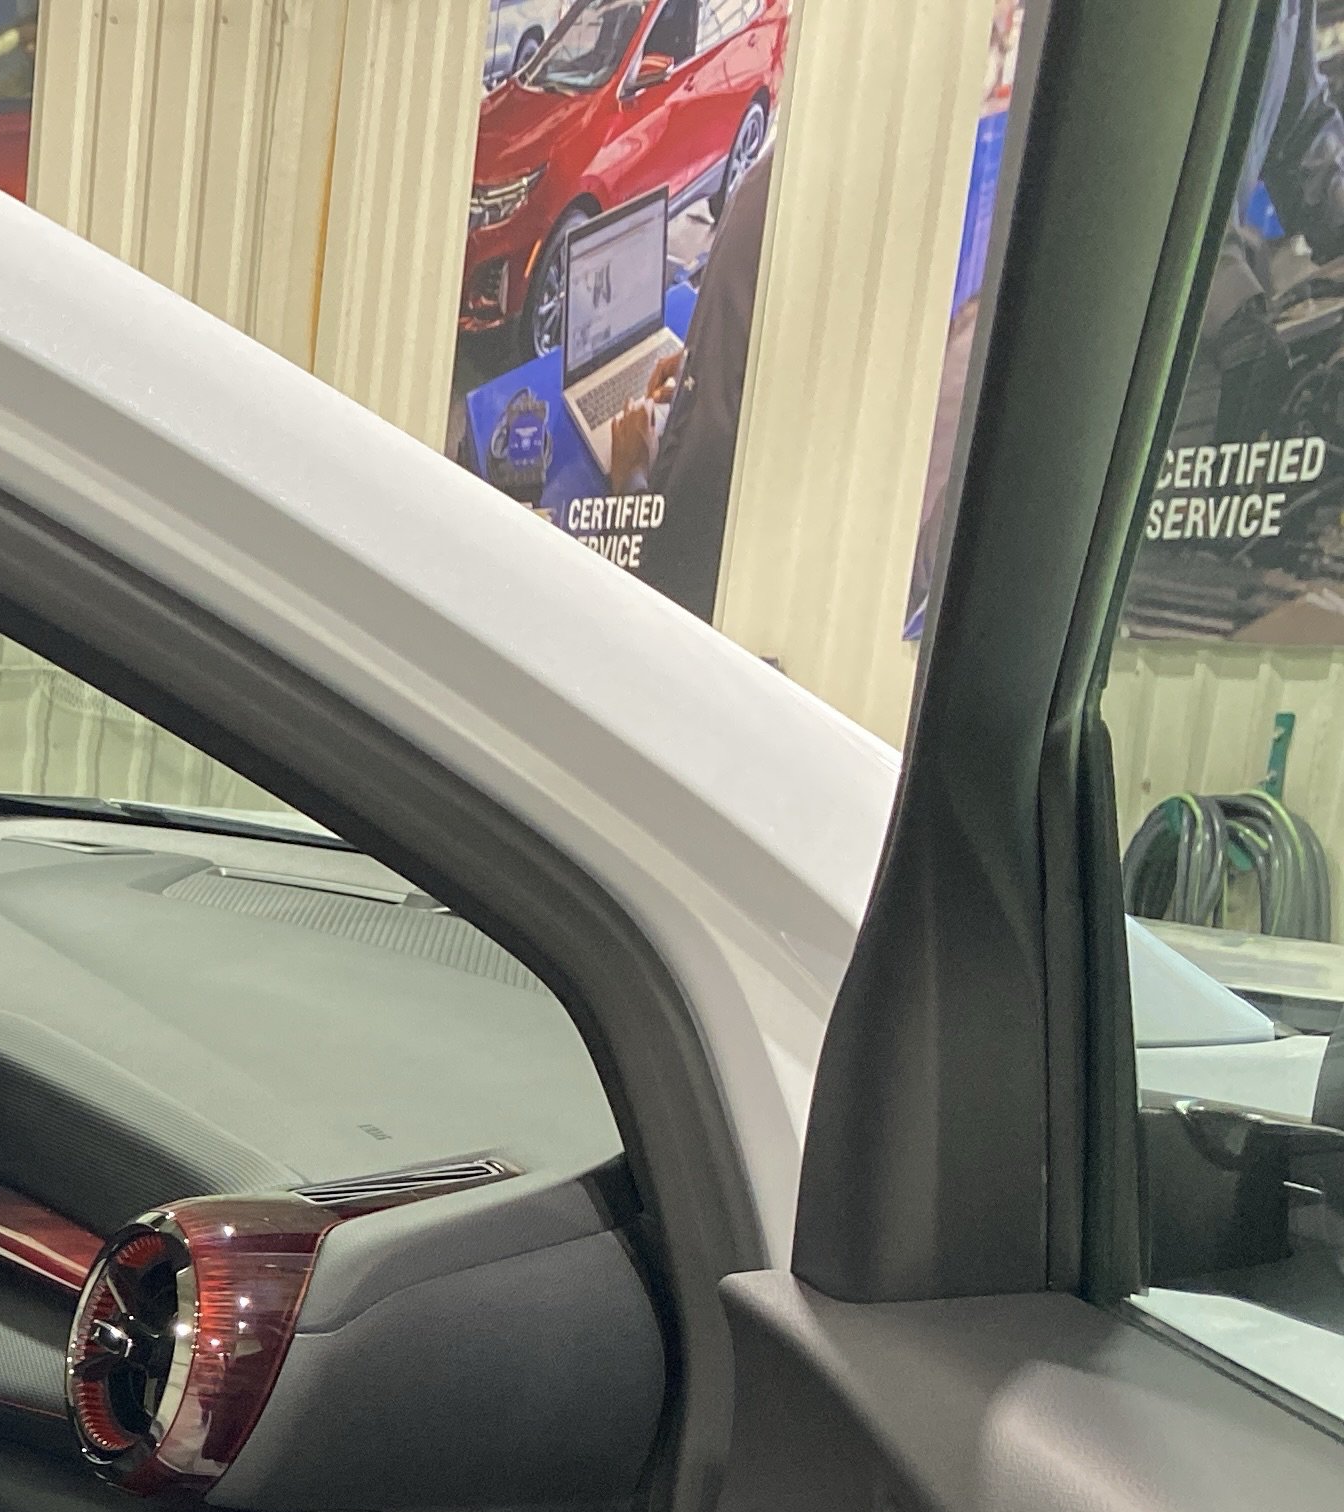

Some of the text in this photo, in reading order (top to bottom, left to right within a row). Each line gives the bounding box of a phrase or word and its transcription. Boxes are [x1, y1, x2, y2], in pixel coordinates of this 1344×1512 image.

[1155, 437, 1327, 490] CERTIFIED
[568, 494, 665, 531] CERTIFIED
[1146, 493, 1286, 541] SERVICE
